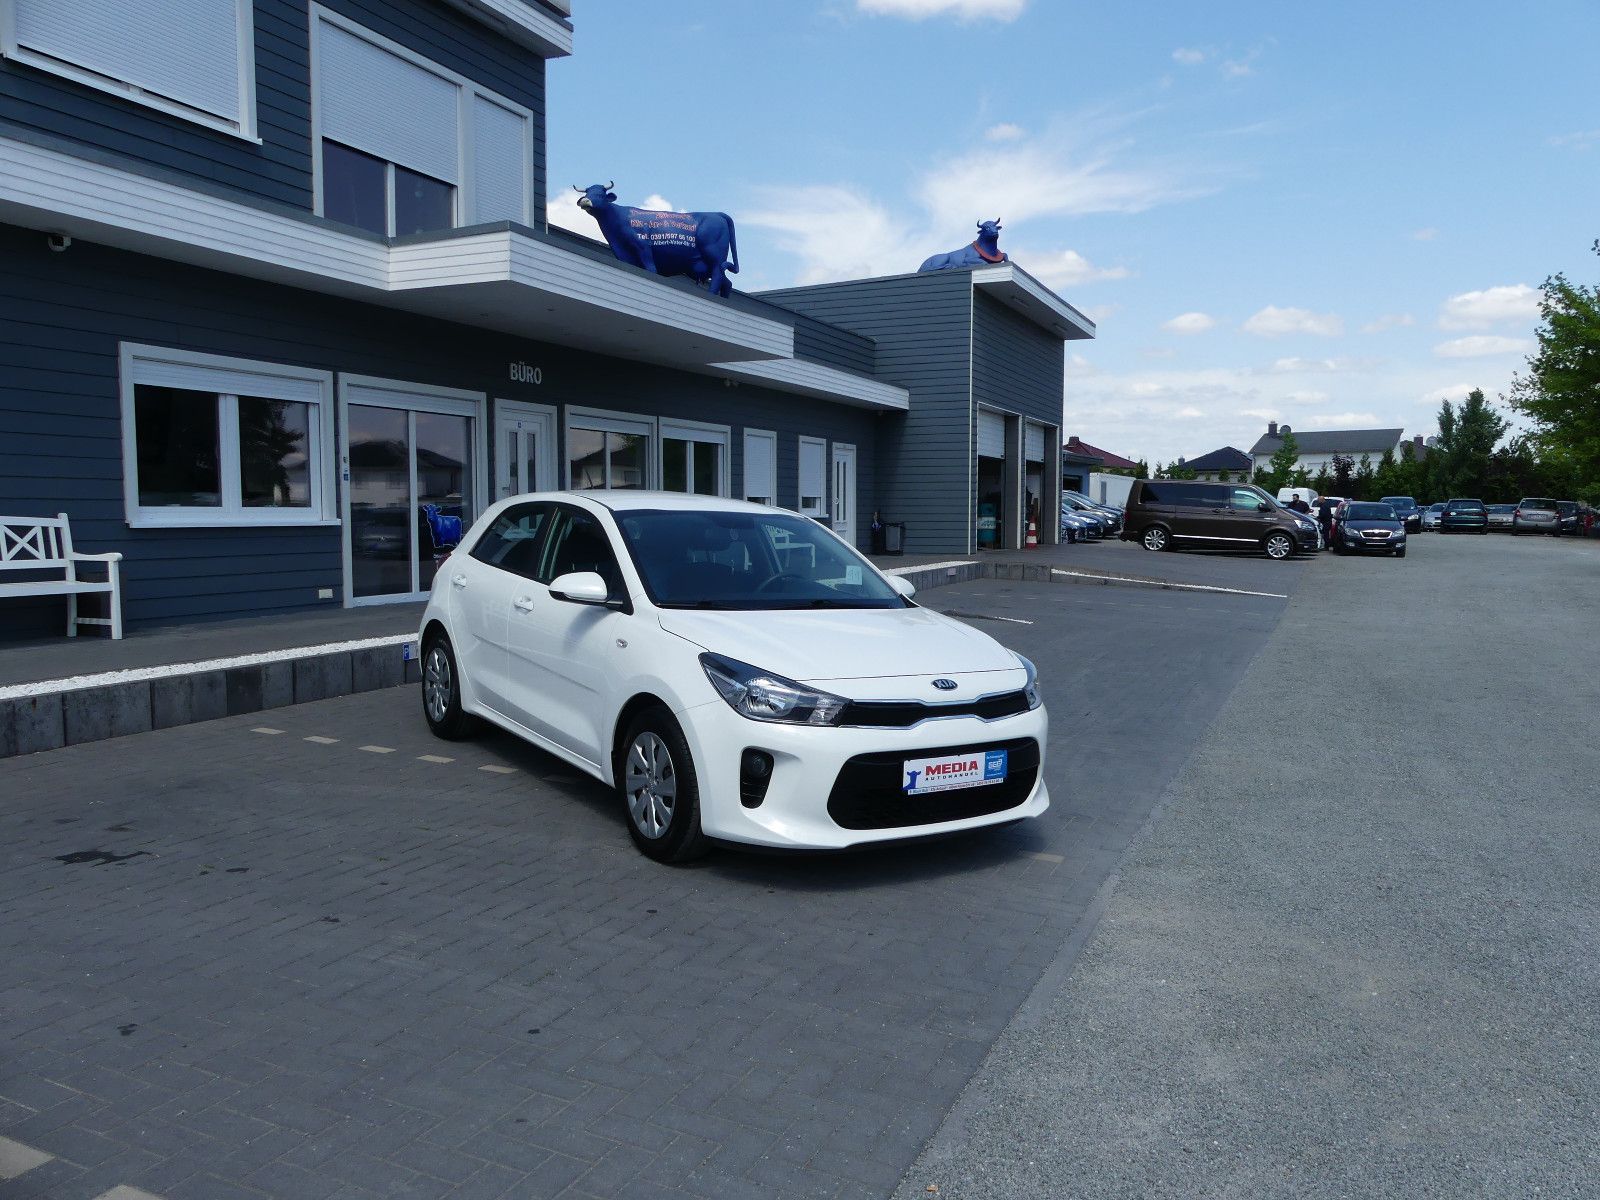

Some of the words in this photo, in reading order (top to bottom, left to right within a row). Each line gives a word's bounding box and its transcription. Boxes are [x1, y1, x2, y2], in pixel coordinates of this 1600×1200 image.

[510, 361, 542, 385] BÜRO
[933, 679, 956, 689] KIA
[925, 760, 979, 776] MEDIA
[925, 771, 979, 781] AUTOHANDEL
